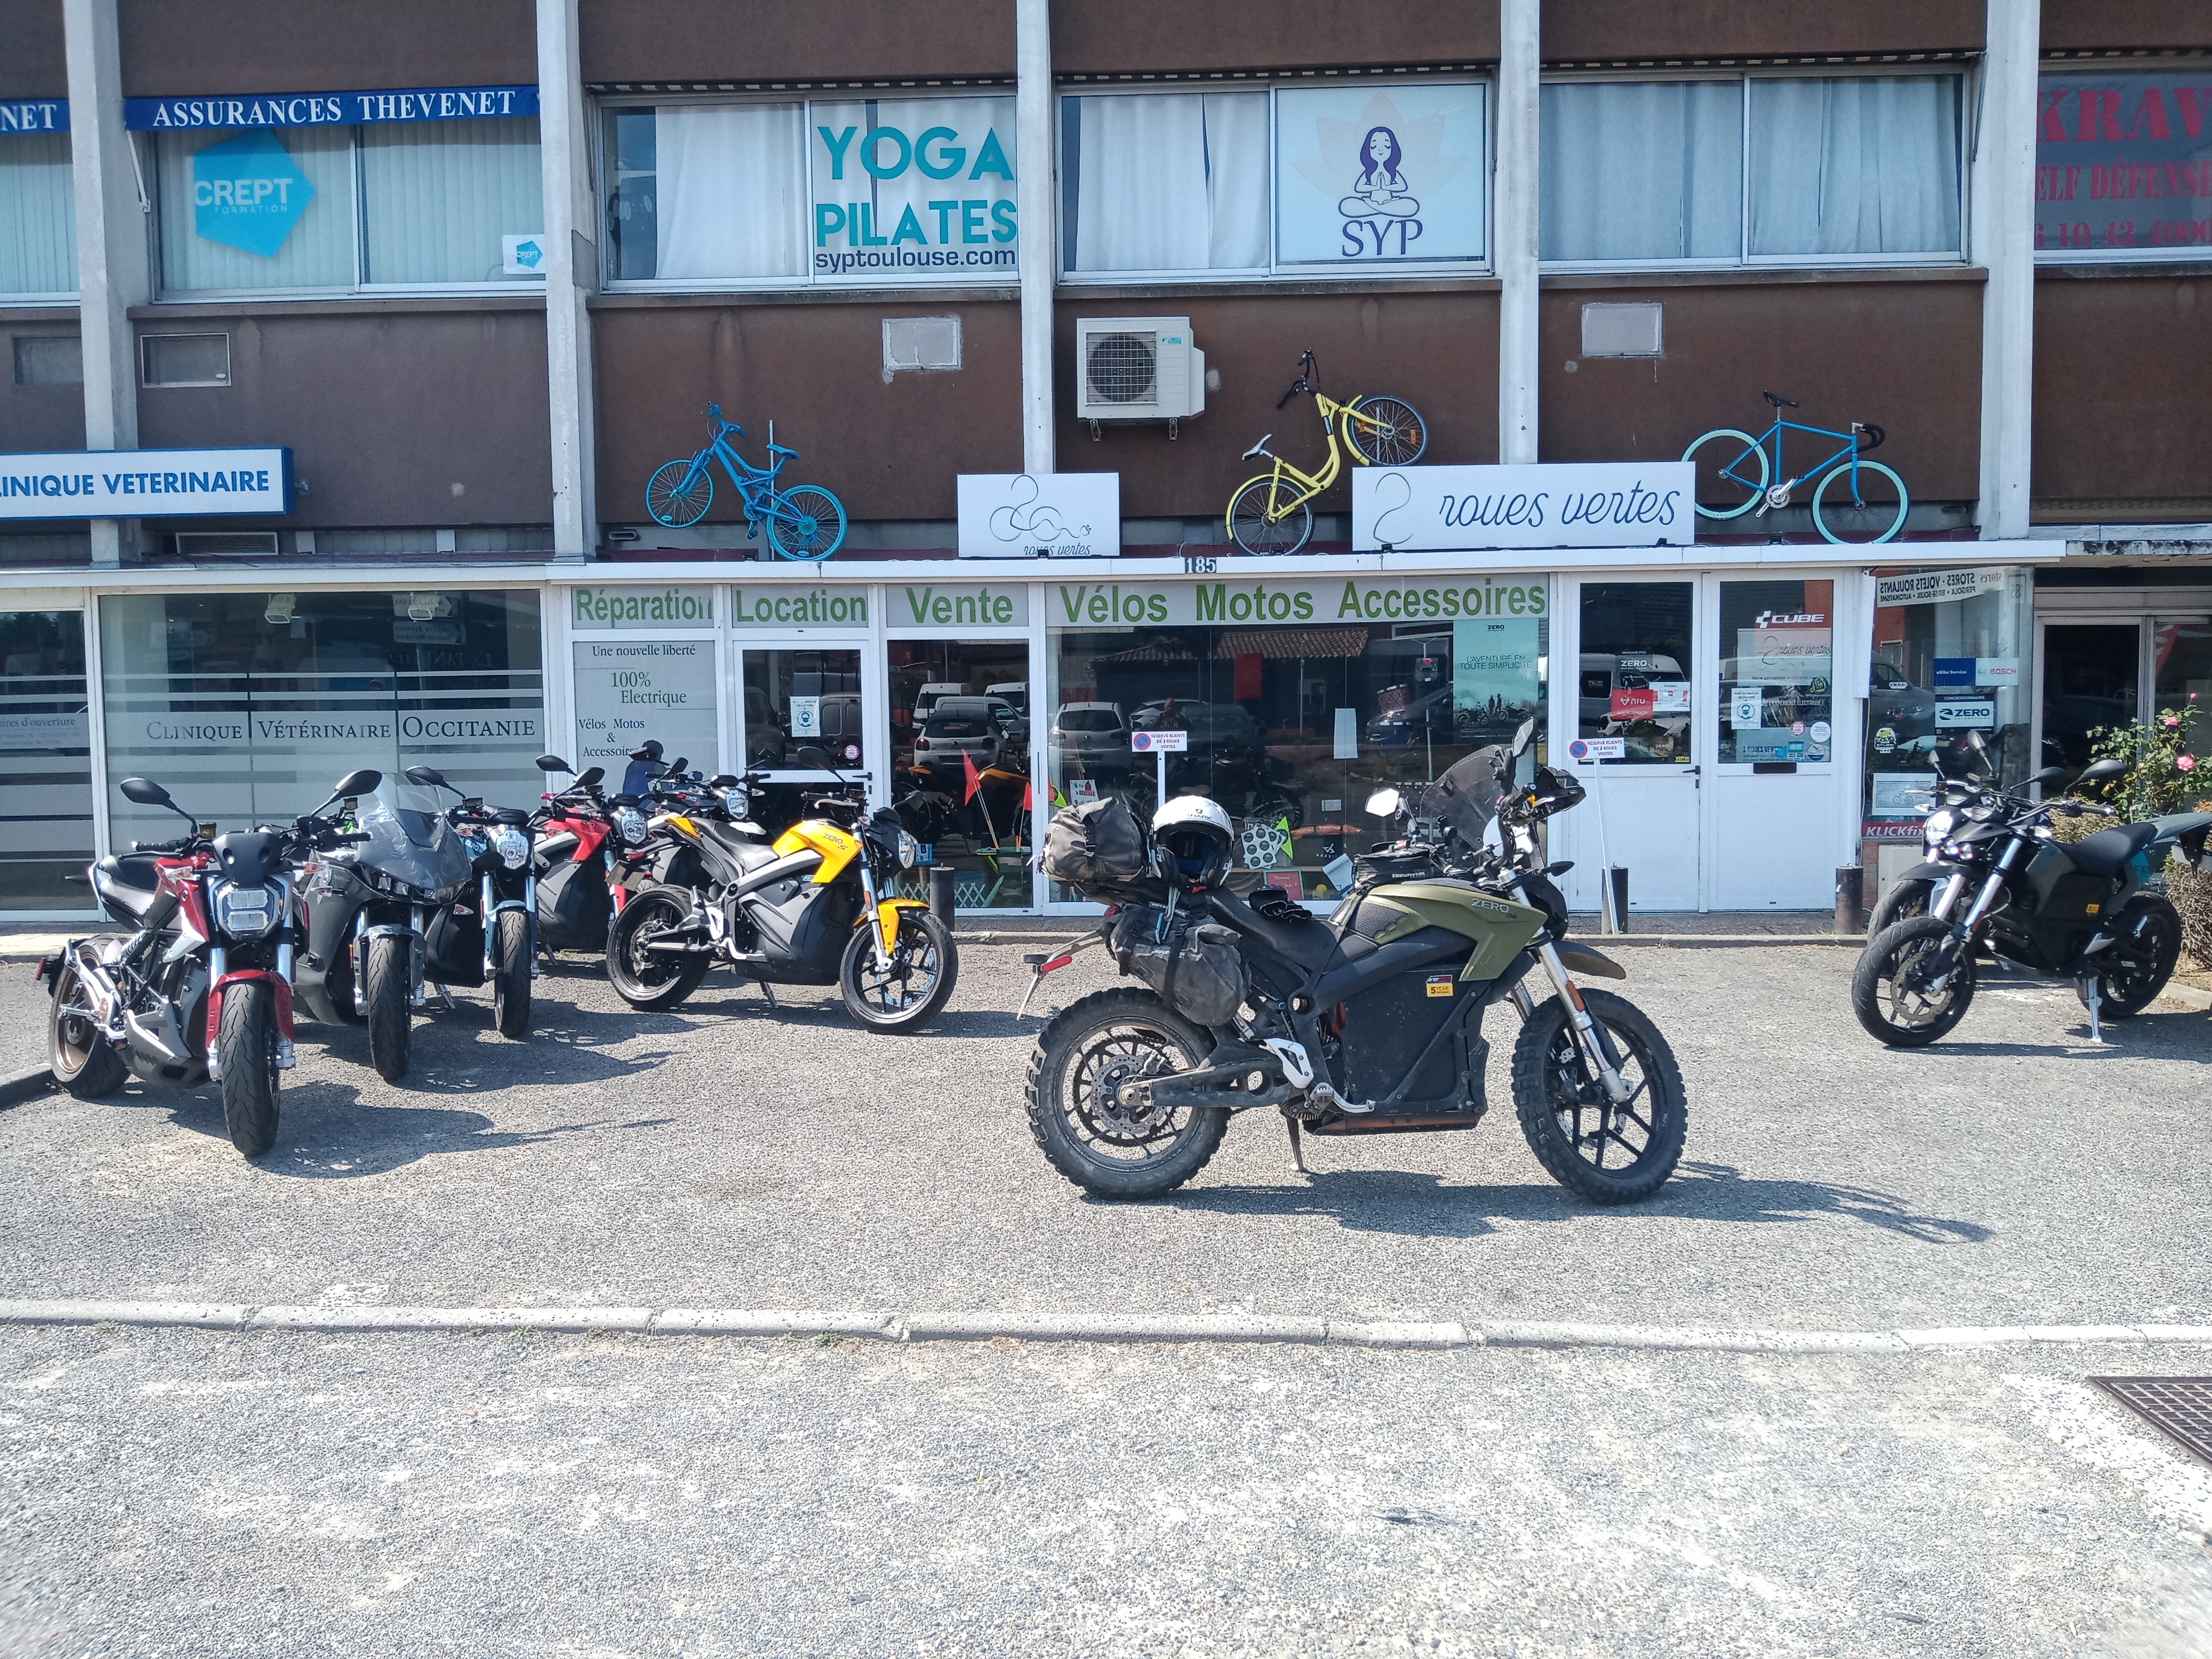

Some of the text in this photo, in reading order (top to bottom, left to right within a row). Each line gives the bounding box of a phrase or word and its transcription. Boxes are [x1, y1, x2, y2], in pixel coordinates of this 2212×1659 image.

[153, 90, 516, 127] ASSURANCES THEVENET
[817, 127, 1015, 180] YOGA
[194, 178, 293, 206] CREPT
[215, 205, 288, 214] FORMATION
[816, 200, 1017, 247] PILATES
[1342, 219, 1423, 257] SYP
[816, 247, 1016, 273] syptoulouse.com
[103, 470, 269, 494] VETERINAIRE
[1439, 493, 1549, 528] roues
[1561, 480, 1680, 526] vertes
[1058, 542, 1091, 555] vertes
[1186, 557, 1216, 574] 185
[576, 588, 714, 628] Réparation
[736, 589, 867, 623] Location
[905, 586, 1013, 624] Vente
[1059, 578, 1546, 624] Vélos Motos Accessoires
[1771, 614, 1825, 623] CUBE
[592, 644, 696, 656] Une nouvelle liberté
[611, 671, 651, 687] 100%
[620, 689, 687, 707] Electrique
[1954, 708, 1990, 717] ZERO
[22, 717, 76, 726] d'ouverture
[258, 718, 392, 739] VÉTÉRINAIRE
[401, 715, 536, 739] OCCITANIE
[579, 718, 645, 729] Vélos Motos
[607, 732, 615, 743] &
[822, 833, 843, 845] ZERO
[1866, 826, 1924, 836] KLICKfix
[465, 840, 480, 850] ZERO
[1471, 898, 1510, 914] ZERO
